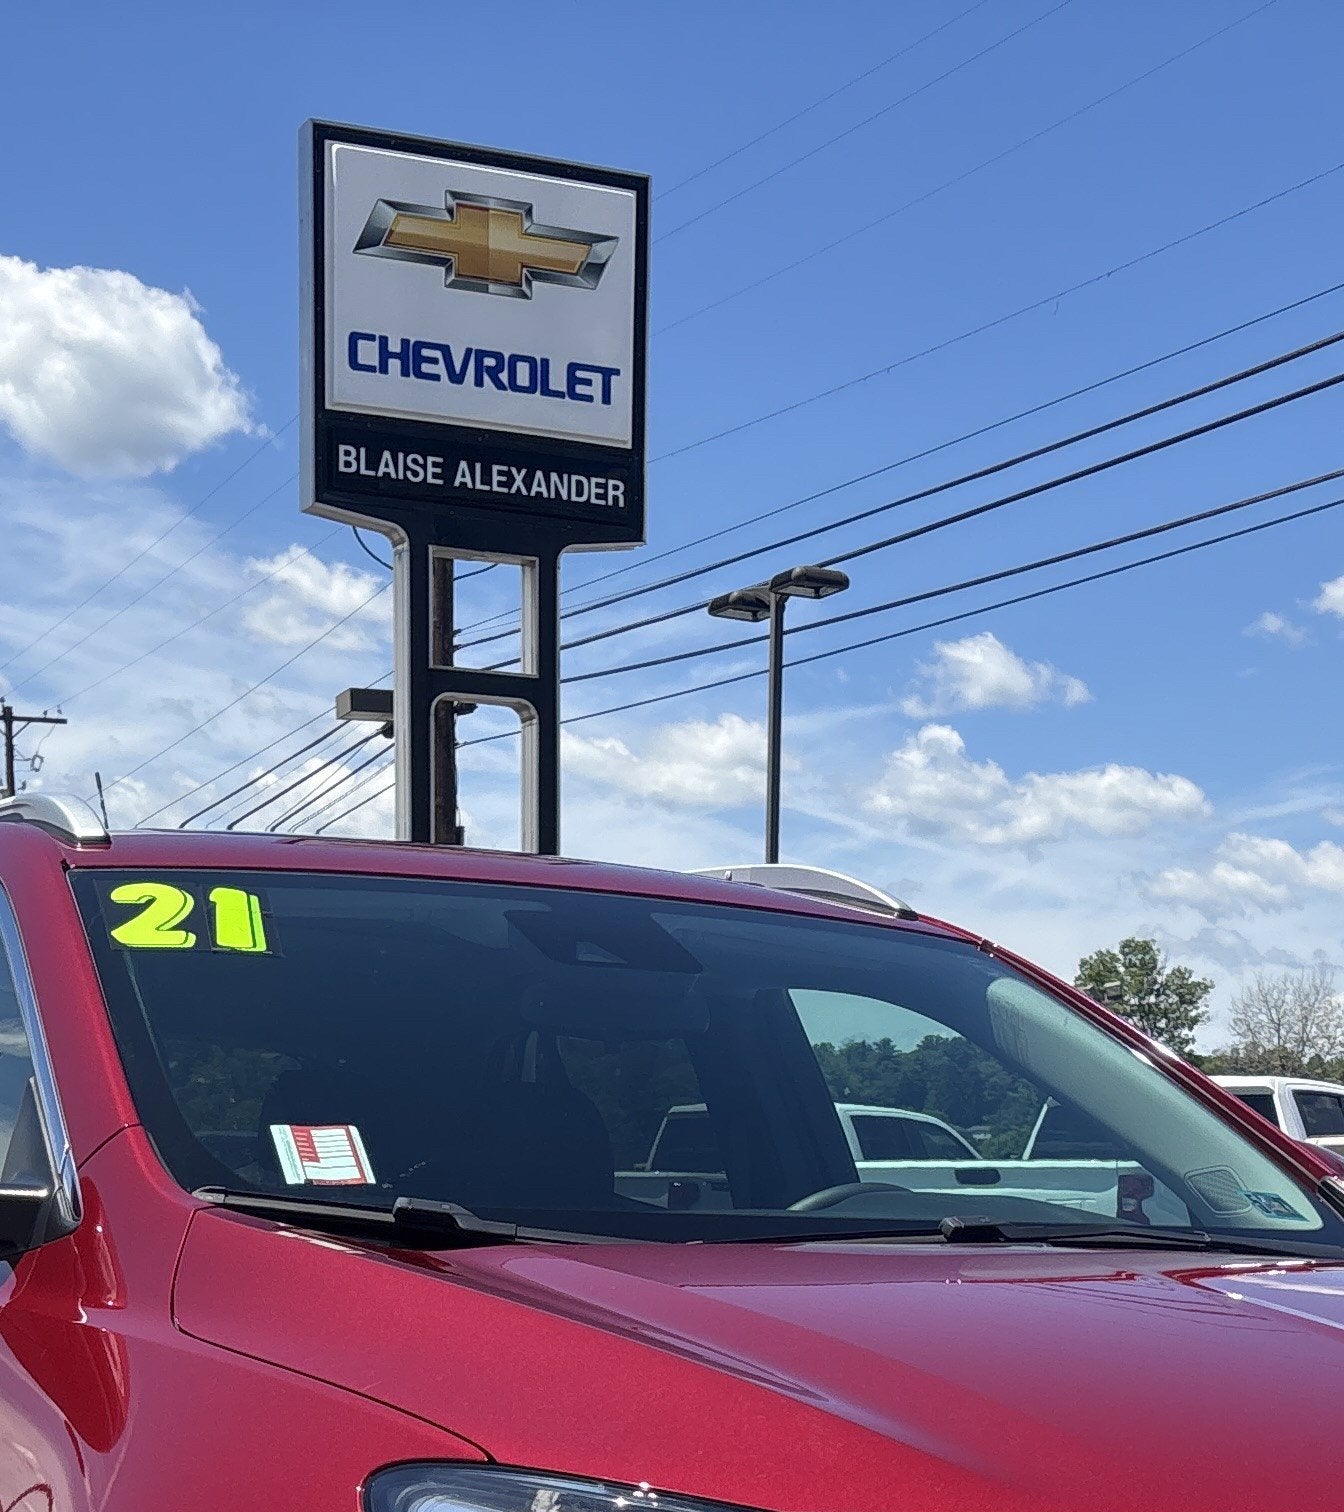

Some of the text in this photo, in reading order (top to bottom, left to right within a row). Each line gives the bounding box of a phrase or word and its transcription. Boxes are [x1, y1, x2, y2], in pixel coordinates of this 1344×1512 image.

[347, 331, 621, 406] CHEVROLET
[338, 443, 626, 508] BLAISE ALEXANDER
[110, 882, 267, 952] 21
